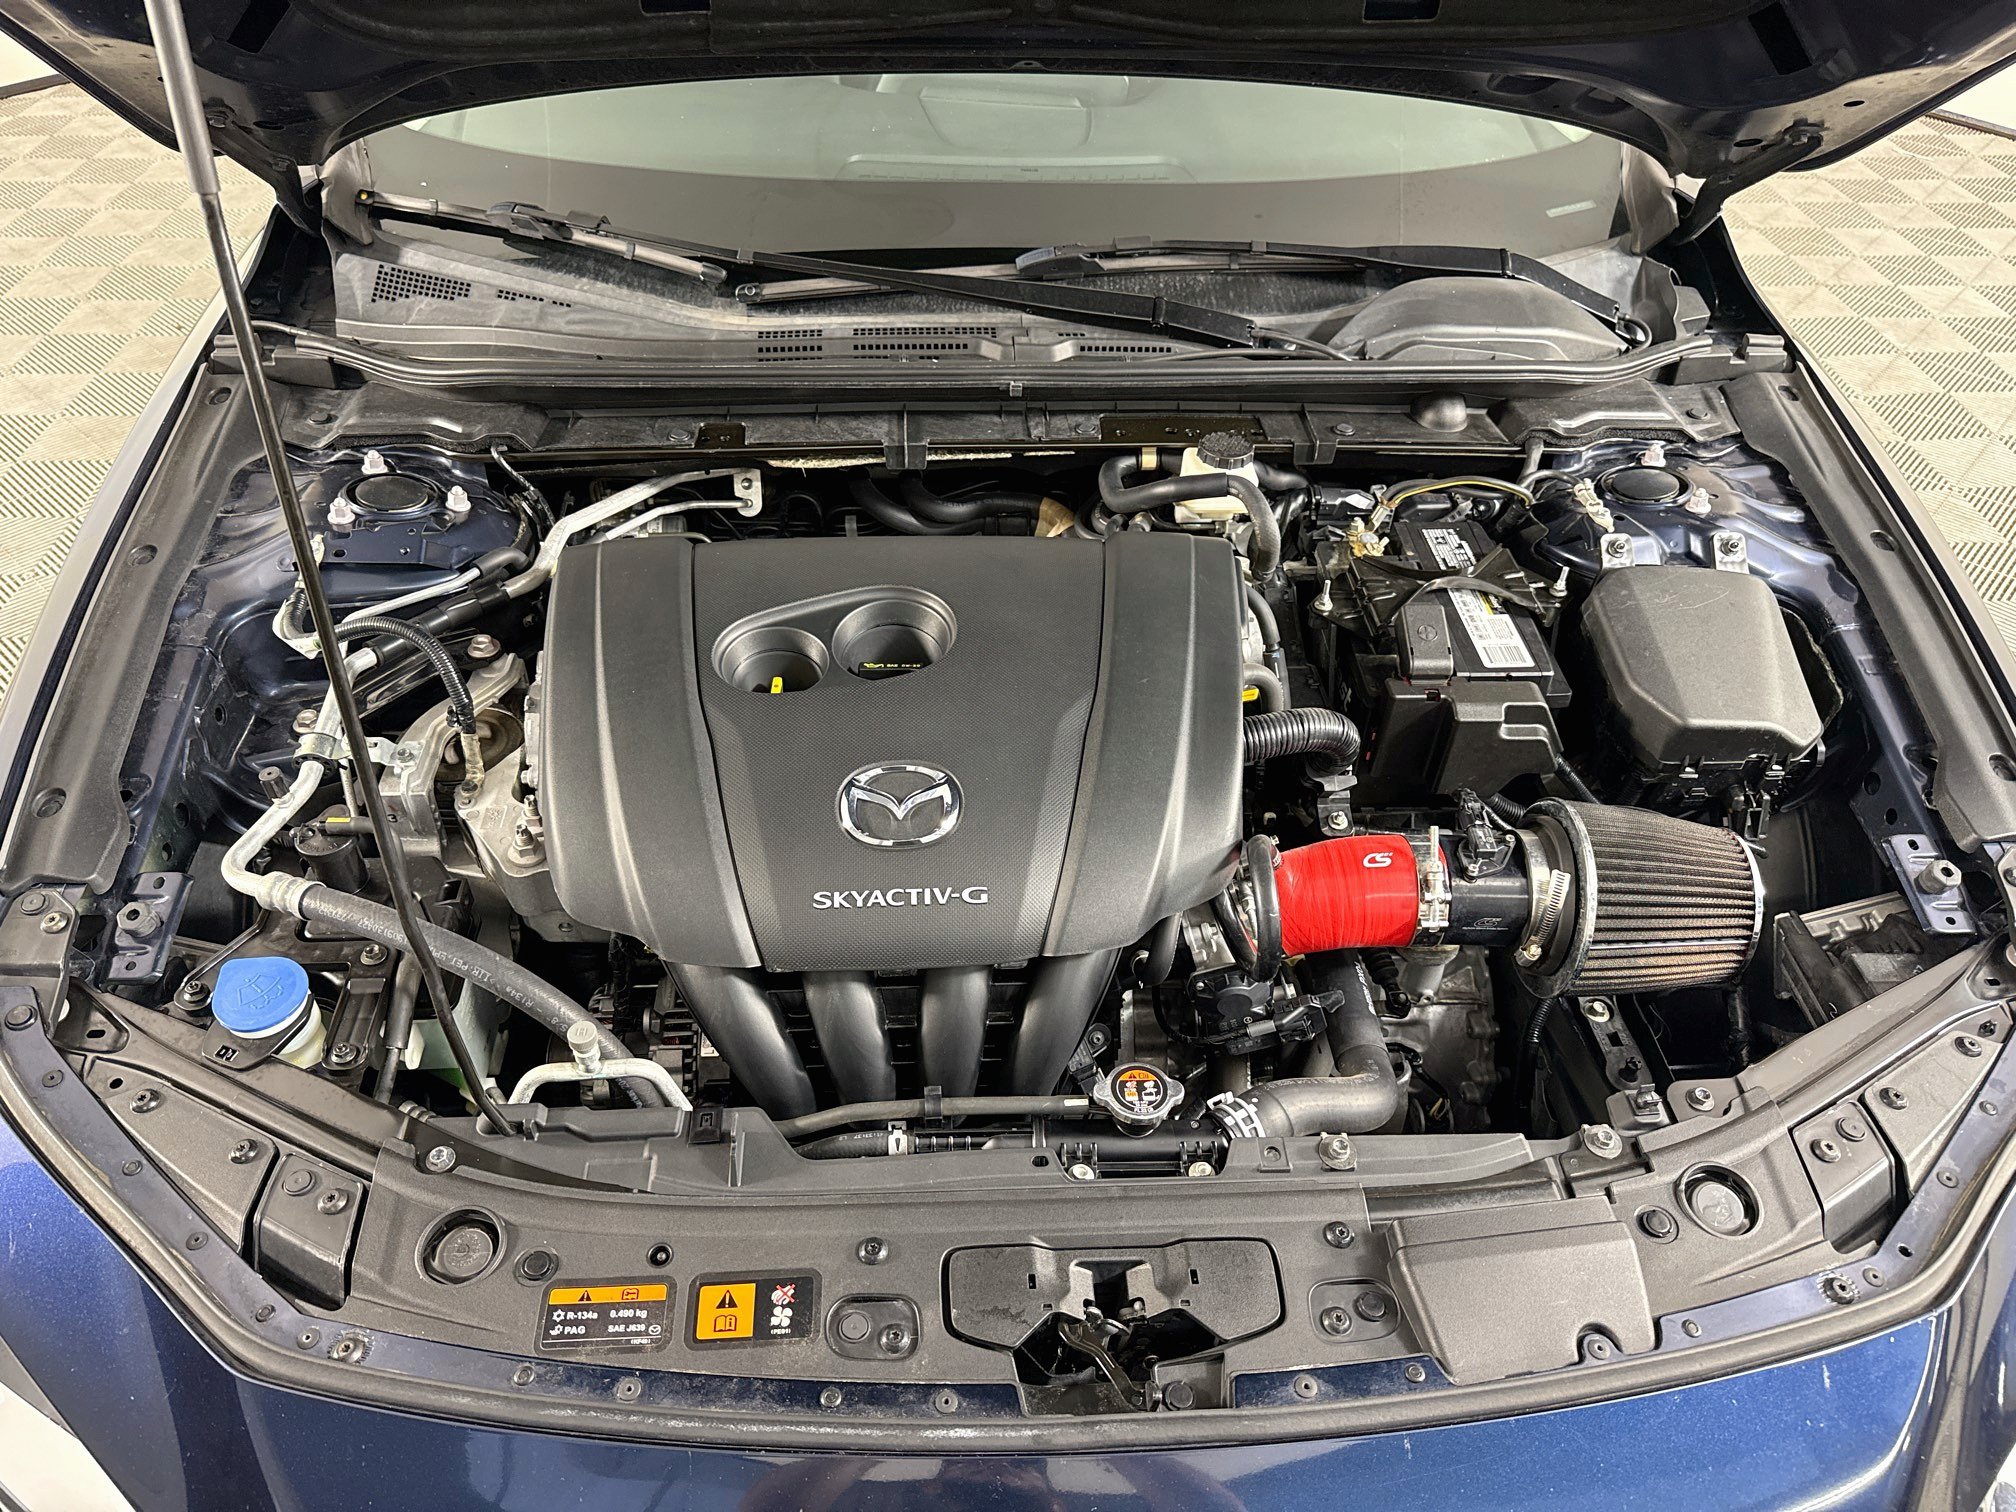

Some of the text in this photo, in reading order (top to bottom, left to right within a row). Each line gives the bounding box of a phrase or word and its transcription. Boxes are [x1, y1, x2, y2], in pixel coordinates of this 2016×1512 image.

[812, 886, 989, 909] SKYACTIV-G
[566, 1309, 648, 1320] R-134a 0.490 kg
[564, 1323, 646, 1335] PAG SAE J639
